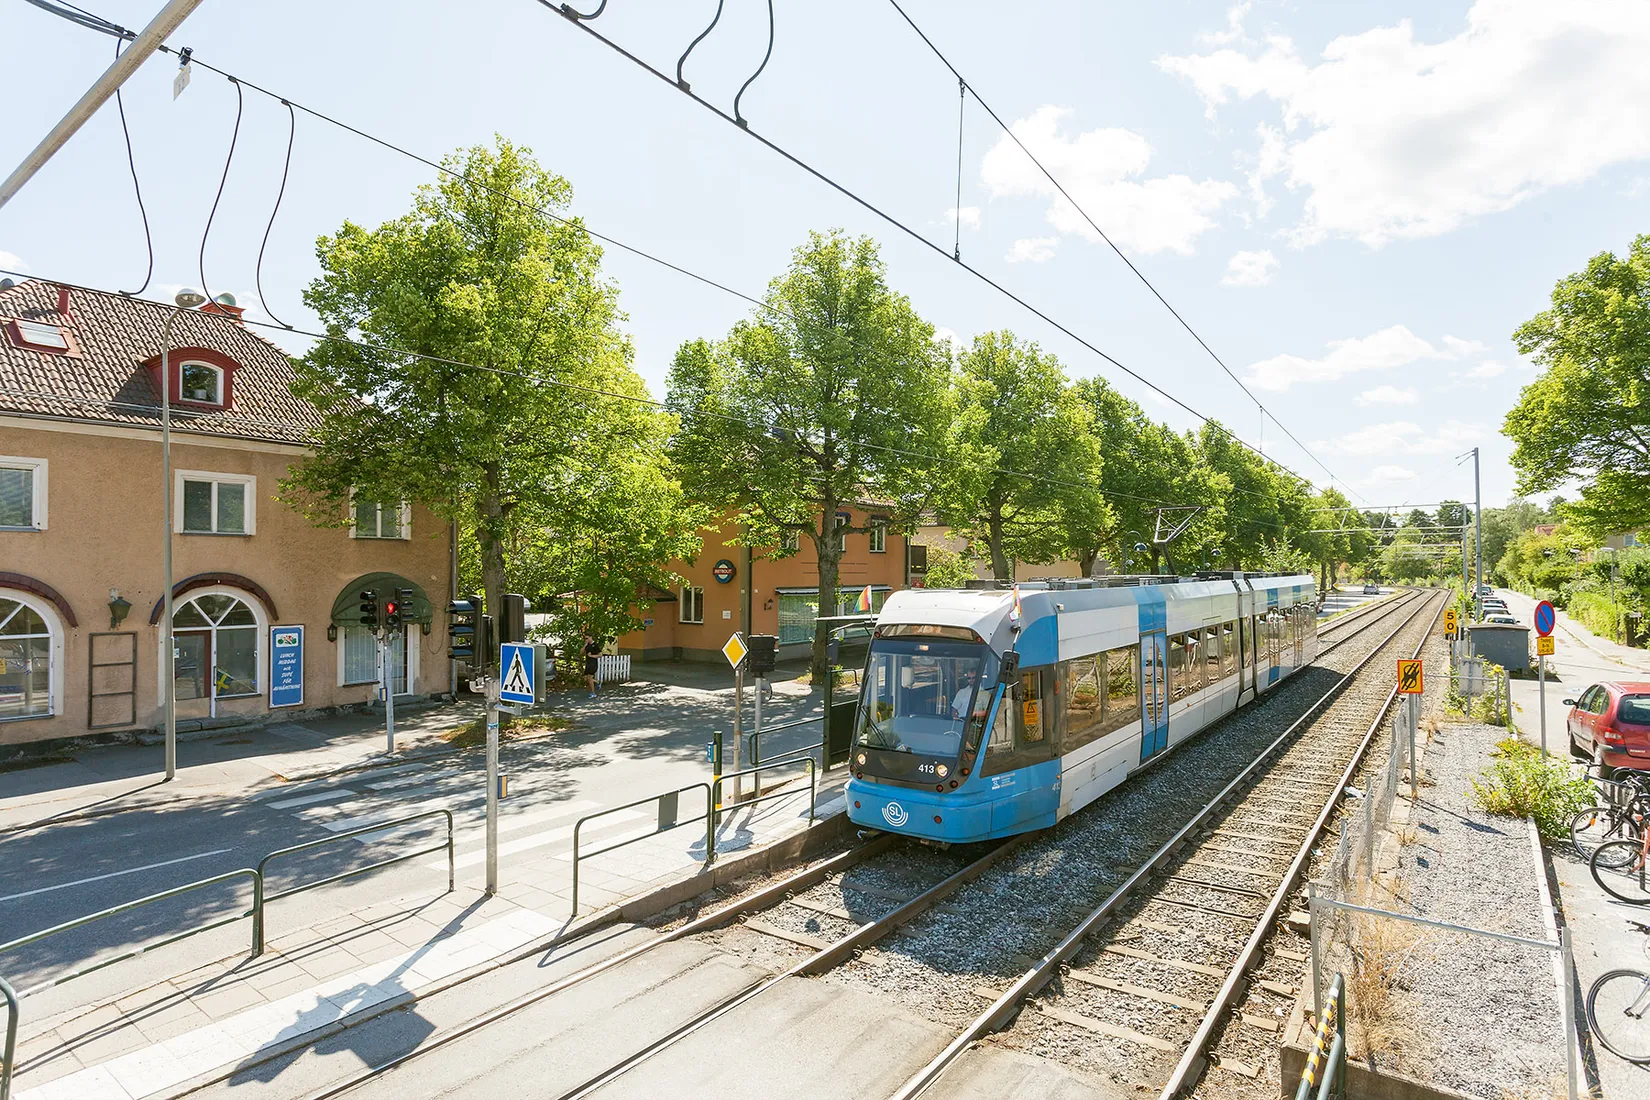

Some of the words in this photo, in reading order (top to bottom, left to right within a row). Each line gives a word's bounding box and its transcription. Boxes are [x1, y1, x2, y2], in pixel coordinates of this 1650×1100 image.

[1447, 612, 1454, 630] 50
[918, 764, 935, 774] 413
[889, 806, 900, 816] SL
